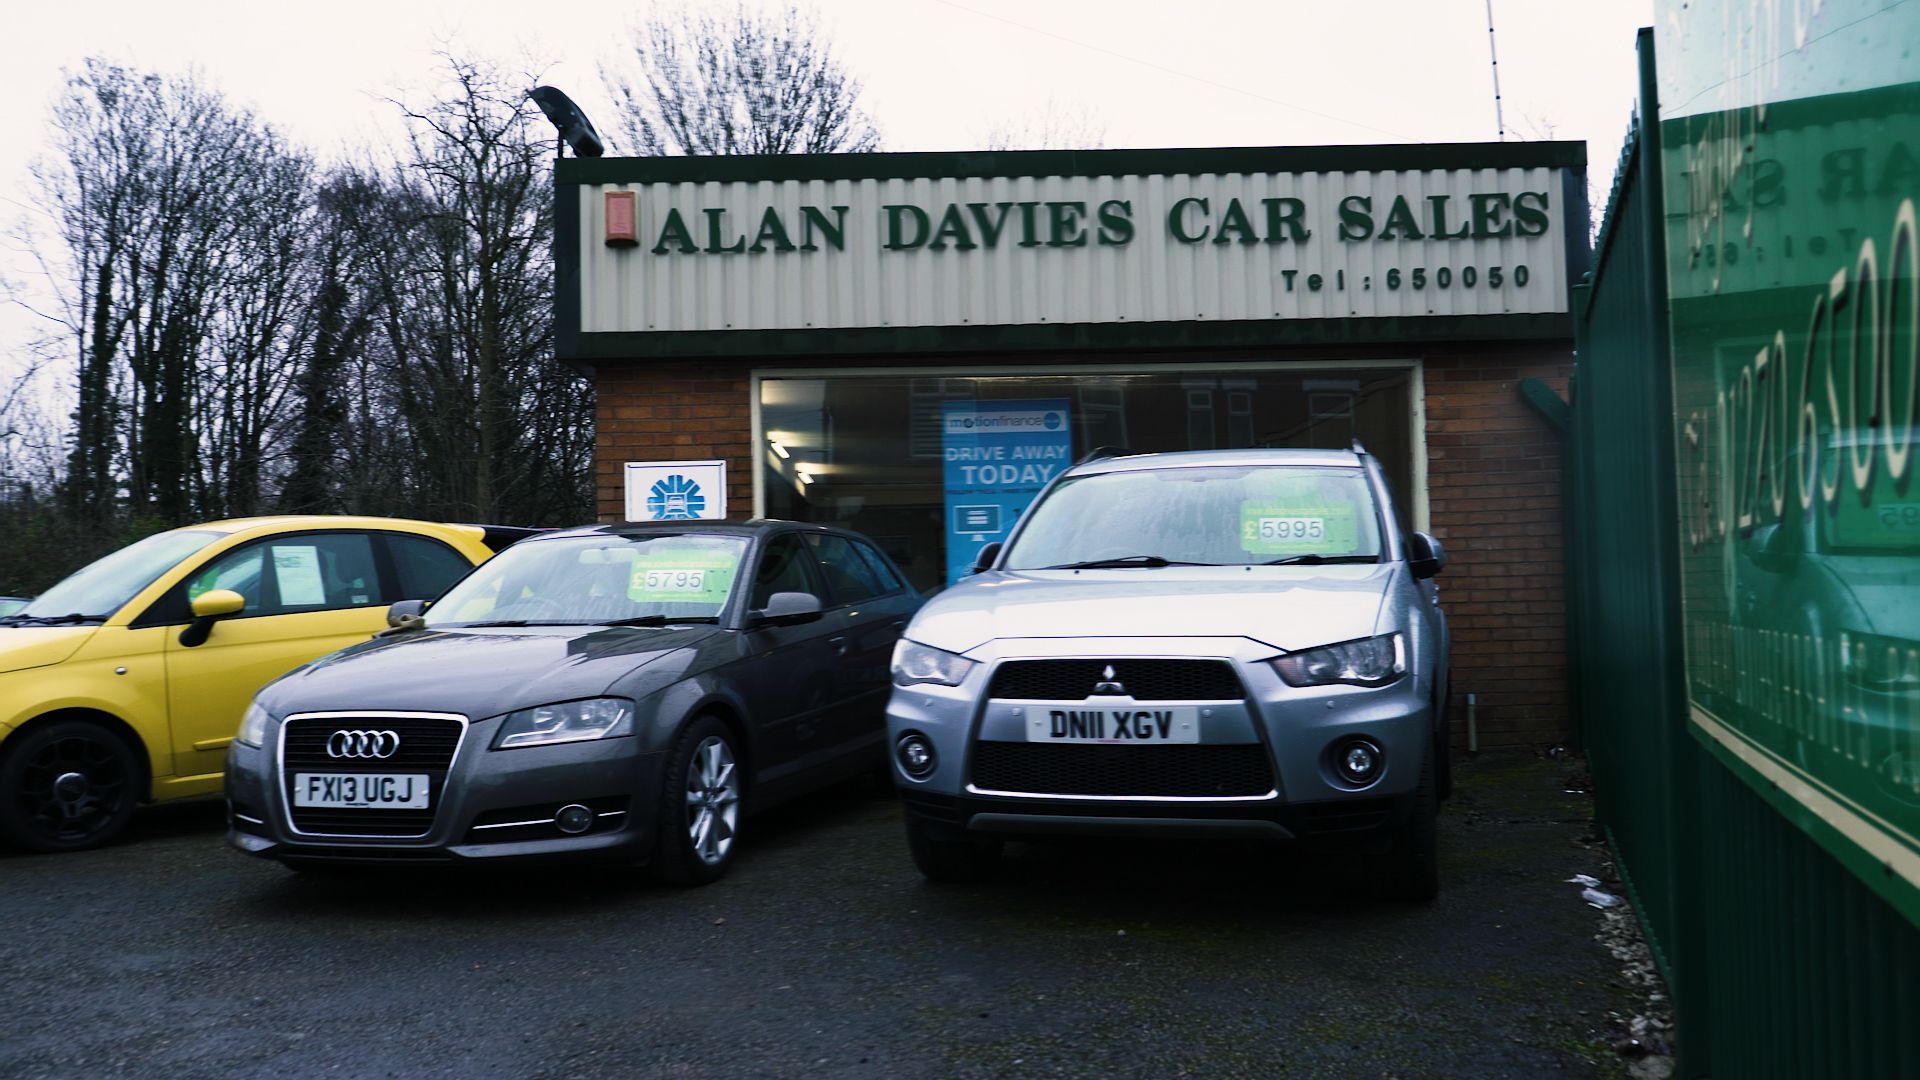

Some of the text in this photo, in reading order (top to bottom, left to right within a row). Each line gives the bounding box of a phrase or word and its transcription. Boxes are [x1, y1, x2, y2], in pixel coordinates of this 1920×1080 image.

[651, 205, 850, 254] ALAN
[883, 198, 1135, 251] DAVIES
[1168, 196, 1311, 245] CAR
[1338, 191, 1550, 241] SALES
[945, 445, 1069, 461] DRIVE AWAY
[960, 464, 1055, 485] TODAY
[1049, 710, 1173, 739] DN11 XGV
[308, 776, 413, 803] FX13 UGJ
